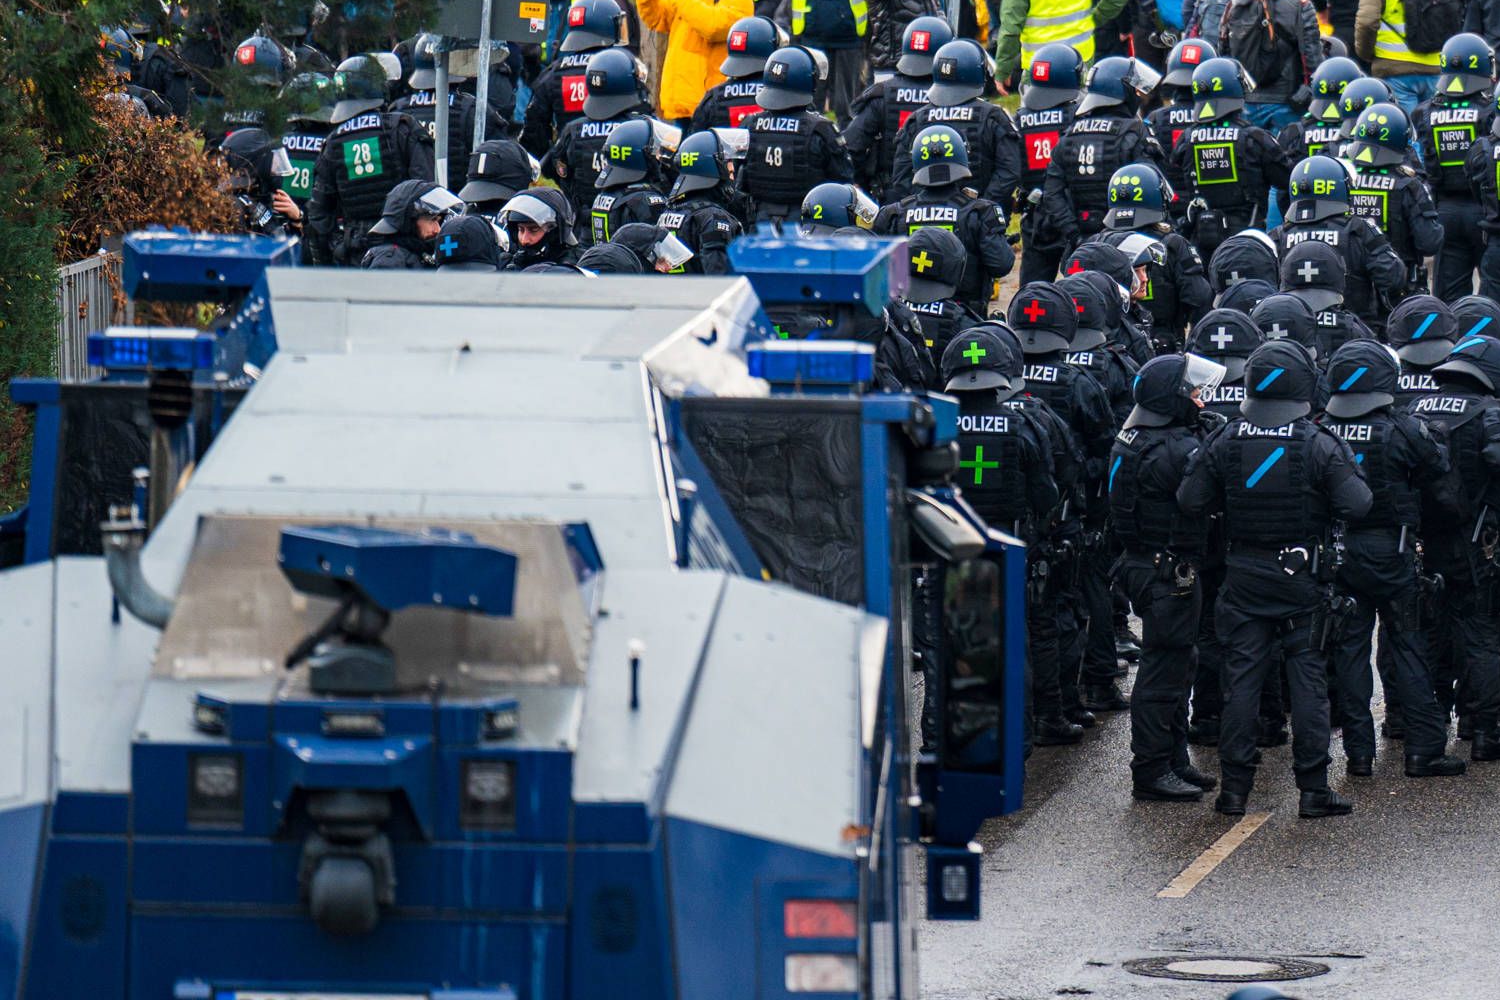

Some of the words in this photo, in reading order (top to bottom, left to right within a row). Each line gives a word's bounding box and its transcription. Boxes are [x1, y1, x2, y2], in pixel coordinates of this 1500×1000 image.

[940, 63, 951, 75] 48
[1441, 54, 1446, 68] 3
[1469, 55, 1478, 68] 2
[772, 64, 783, 76] 48
[1036, 65, 1046, 77] 28
[591, 76, 601, 86] 48
[1192, 81, 1198, 94] 3
[1212, 77, 1222, 92] 2
[1320, 80, 1327, 94] 3
[1338, 81, 1348, 94] 2
[570, 82, 585, 102] 28
[896, 88, 931, 104] POLIZ
[1345, 98, 1352, 112] 3
[1364, 97, 1374, 108] 2
[928, 107, 972, 121] POLIZEI
[1020, 111, 1062, 128] POLIZEI
[1430, 109, 1478, 125] POLIZEI
[337, 114, 381, 134] POLIZEI
[756, 118, 800, 133] POLIZEI
[1073, 120, 1112, 134] POLIZEI
[1360, 123, 1366, 137] 3
[1380, 128, 1389, 140] 2
[1190, 128, 1239, 143] POLIZEI
[1304, 128, 1341, 144] POLIZ
[1442, 130, 1464, 141] NRW
[610, 145, 632, 161] BF
[920, 146, 930, 160] 3
[944, 143, 954, 157] 2
[1034, 139, 1050, 160] 28
[1440, 142, 1446, 151] 3
[1446, 142, 1457, 151] BF
[1460, 141, 1470, 150] 23
[352, 143, 371, 166] 28
[680, 152, 700, 168] BF
[765, 147, 782, 167] 48
[1078, 144, 1095, 166] 48
[1202, 149, 1224, 160] NRW
[1200, 160, 1206, 170] 3
[1208, 160, 1218, 170] BF
[1220, 160, 1230, 169] 23
[291, 168, 310, 190] 28
[1292, 181, 1298, 196] 3
[1314, 178, 1336, 196] BF
[1111, 188, 1117, 202] 3
[1133, 187, 1143, 201] 2
[1353, 196, 1378, 206] NRW
[813, 204, 822, 220] 2
[906, 206, 958, 223] POLIZEI
[1350, 208, 1356, 216] 3
[1357, 208, 1368, 216] BF
[1370, 208, 1381, 216] 23
[1022, 365, 1058, 382] LIZEI
[1200, 386, 1248, 402] OLIZEI
[1416, 398, 1467, 413] POLIZEI
[1238, 421, 1293, 438] POLIZEI
